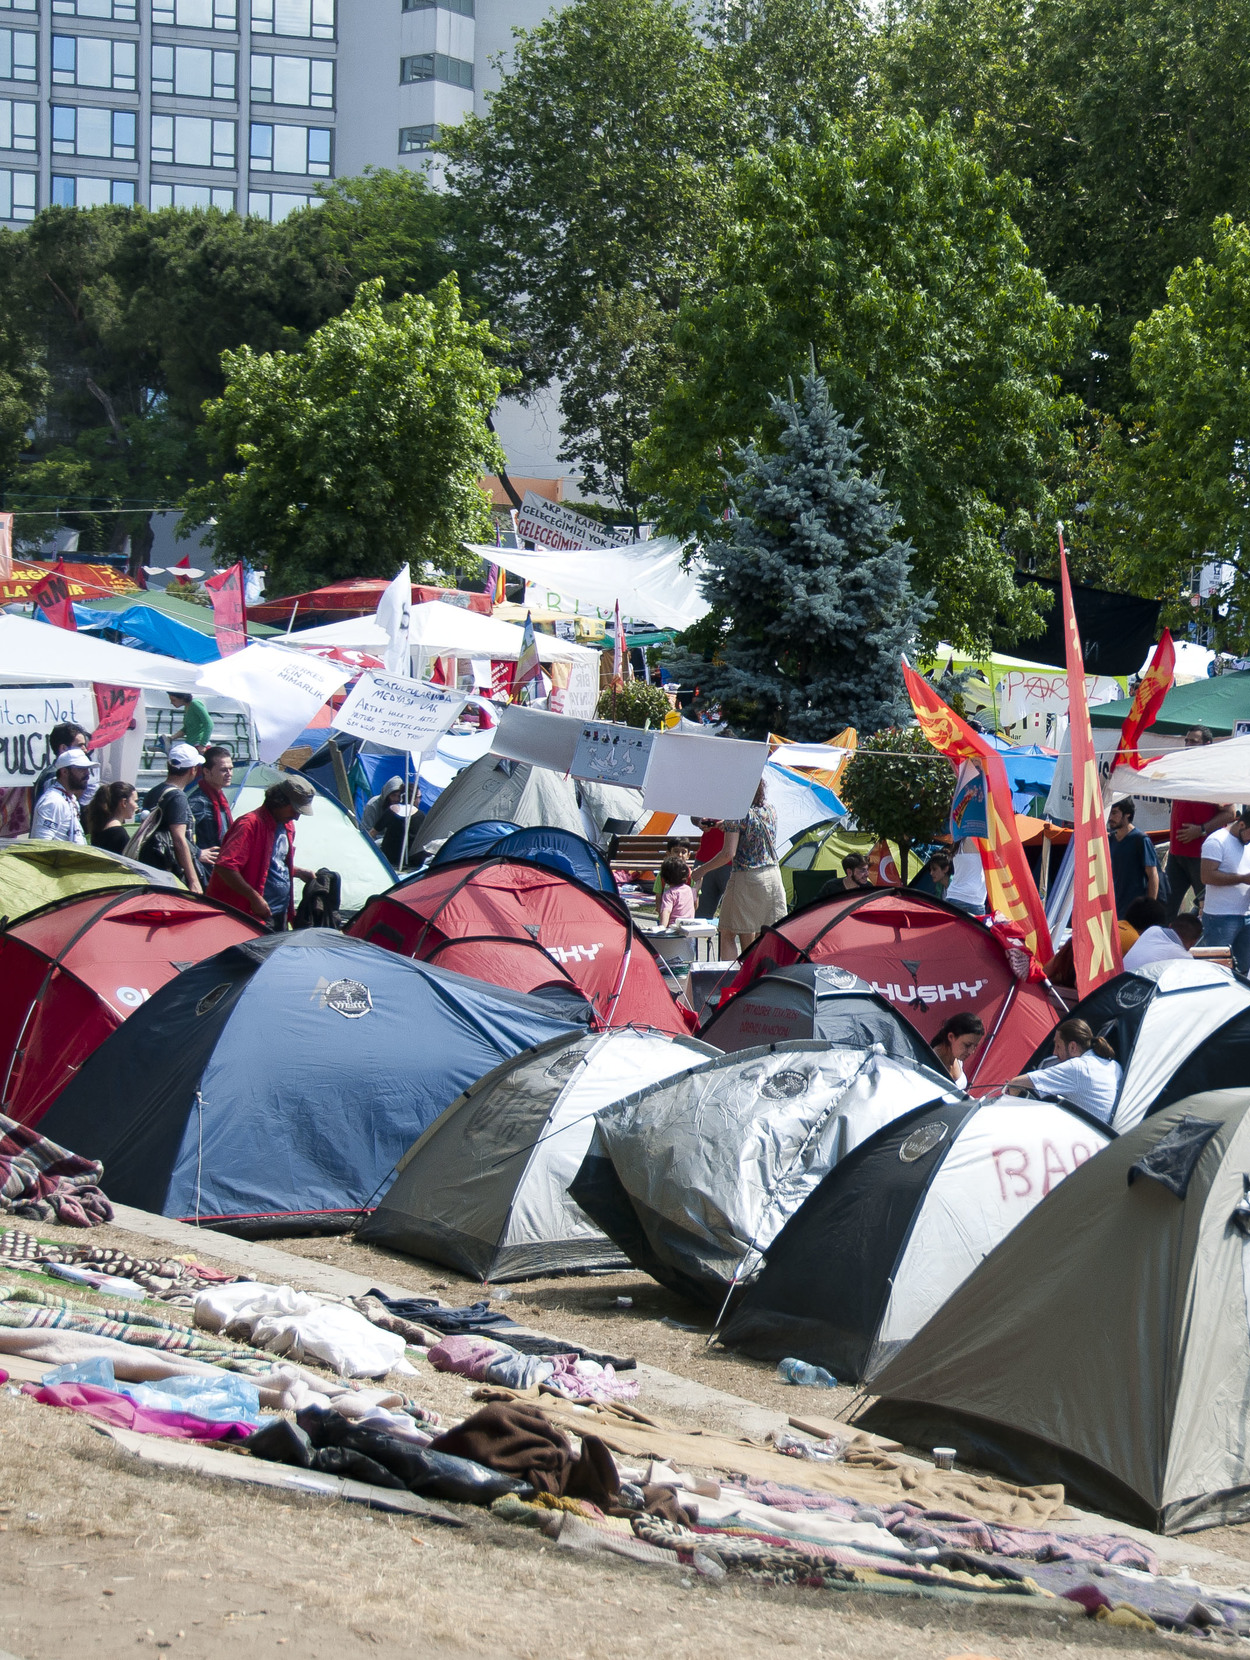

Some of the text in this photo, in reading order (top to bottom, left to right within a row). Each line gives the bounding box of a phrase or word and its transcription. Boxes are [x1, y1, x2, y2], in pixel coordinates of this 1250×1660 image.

[541, 501, 561, 514] AKP
[522, 505, 607, 549] GELECEĞİMİZİ YOK
[44, 699, 79, 723] Net
[871, 978, 984, 1003] HUSKY
